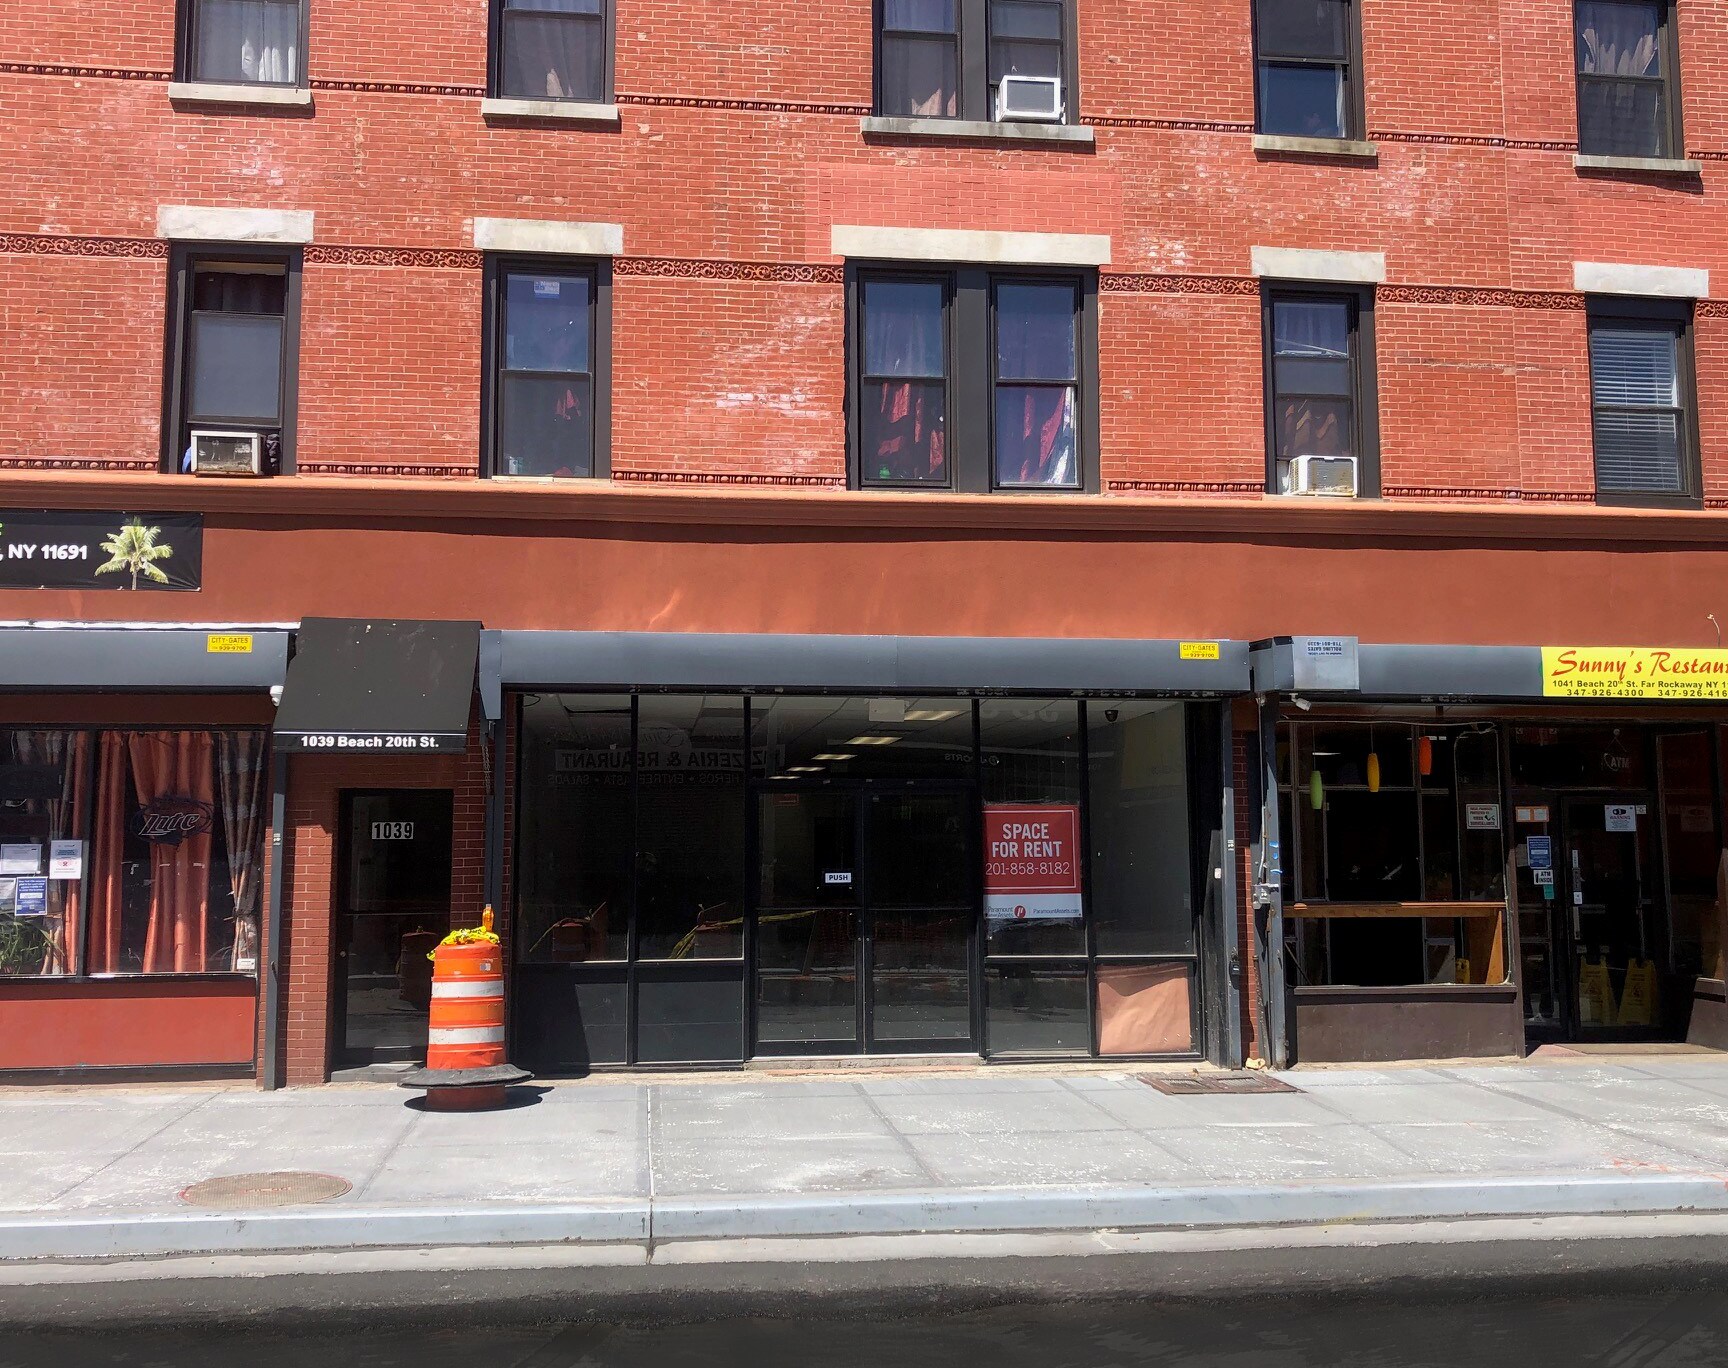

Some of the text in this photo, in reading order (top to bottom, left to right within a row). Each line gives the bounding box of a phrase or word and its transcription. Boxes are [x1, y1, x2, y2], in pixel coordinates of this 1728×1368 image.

[8, 543, 37, 559] NY
[41, 544, 88, 560] 11691
[1551, 650, 1643, 680] Sunny's
[1567, 689, 1644, 697] 347-926-4300
[1658, 681, 1703, 690] Rockaway
[300, 735, 439, 748] 1039 Beach 20th St.
[373, 822, 413, 839] 1039
[1002, 823, 1049, 840] SPACE
[992, 841, 1062, 858] FOR RENT
[985, 861, 1070, 875] 201-858-8182
